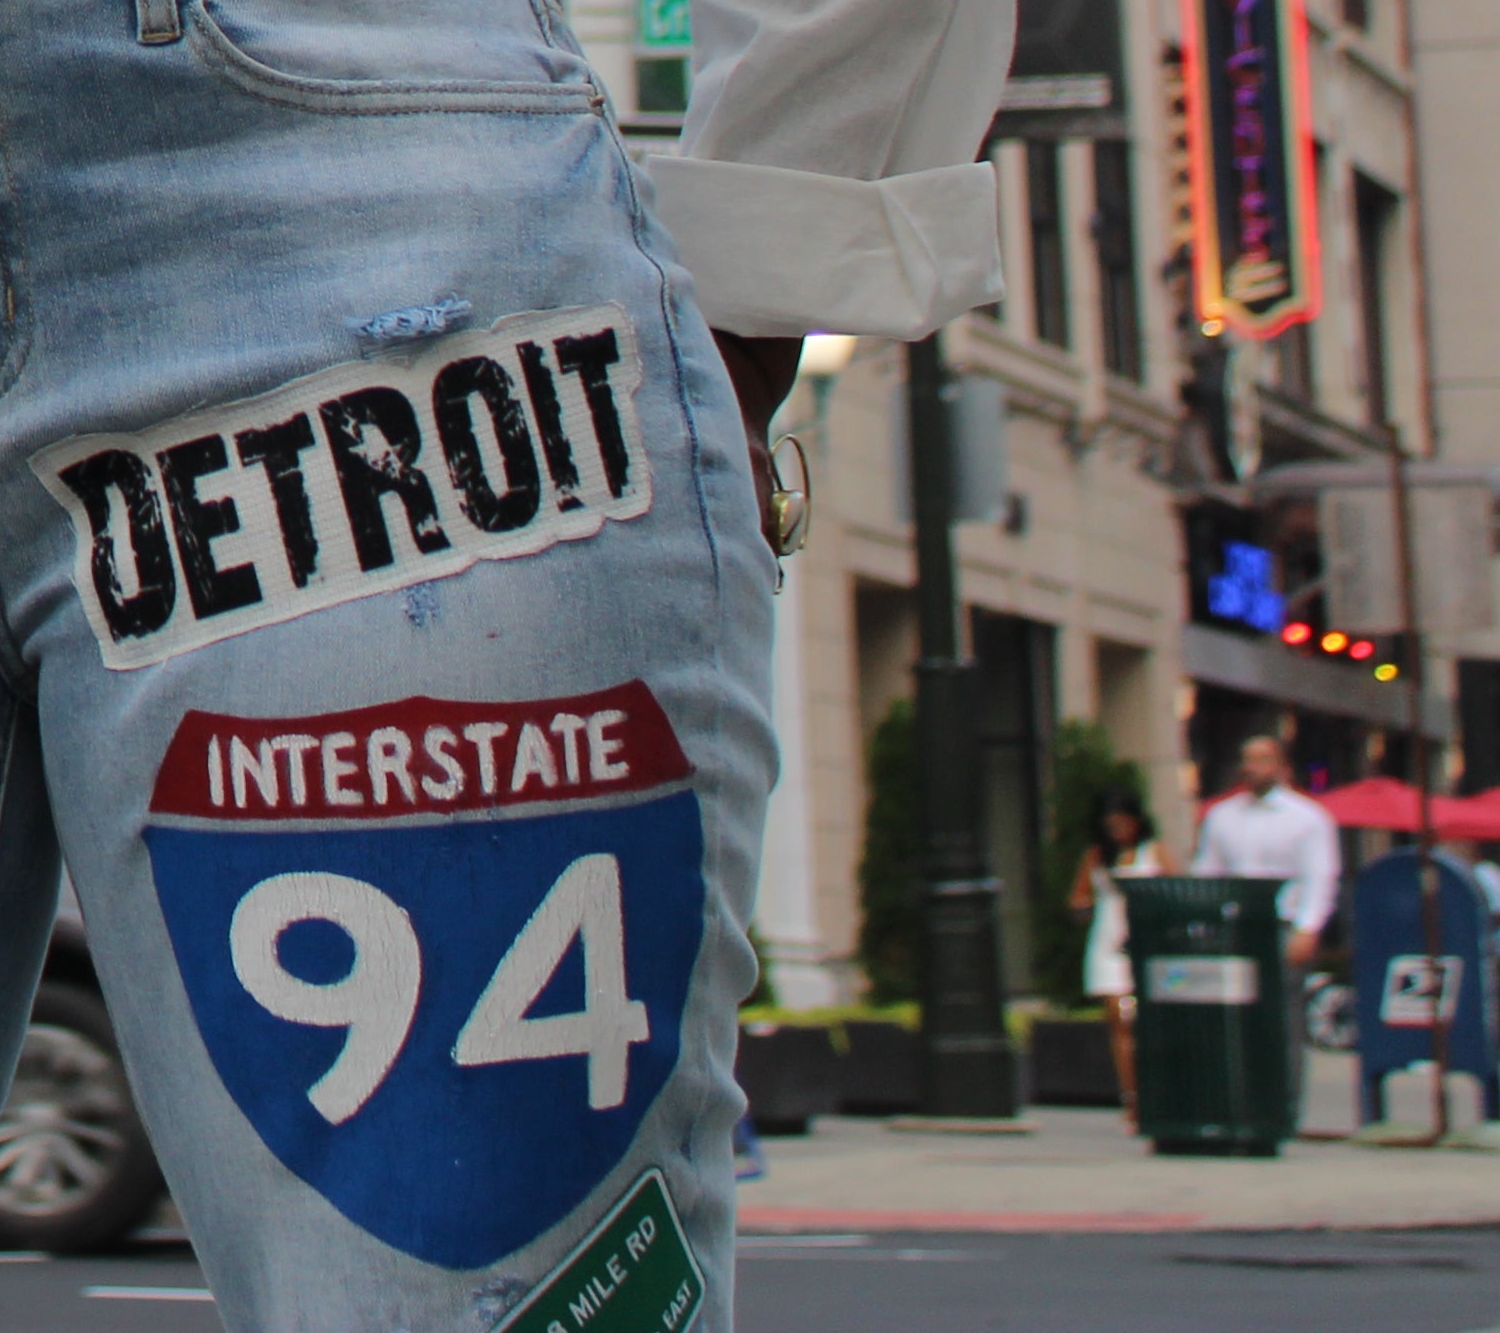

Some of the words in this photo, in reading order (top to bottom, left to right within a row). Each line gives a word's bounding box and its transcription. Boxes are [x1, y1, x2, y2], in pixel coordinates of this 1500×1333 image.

[60, 328, 636, 641] DETROIT
[208, 710, 631, 810] INTERSTATE
[229, 852, 650, 1126] 94
[568, 1253, 629, 1328] MILE
[625, 1214, 657, 1262] RD
[662, 1279, 691, 1330] EAST
